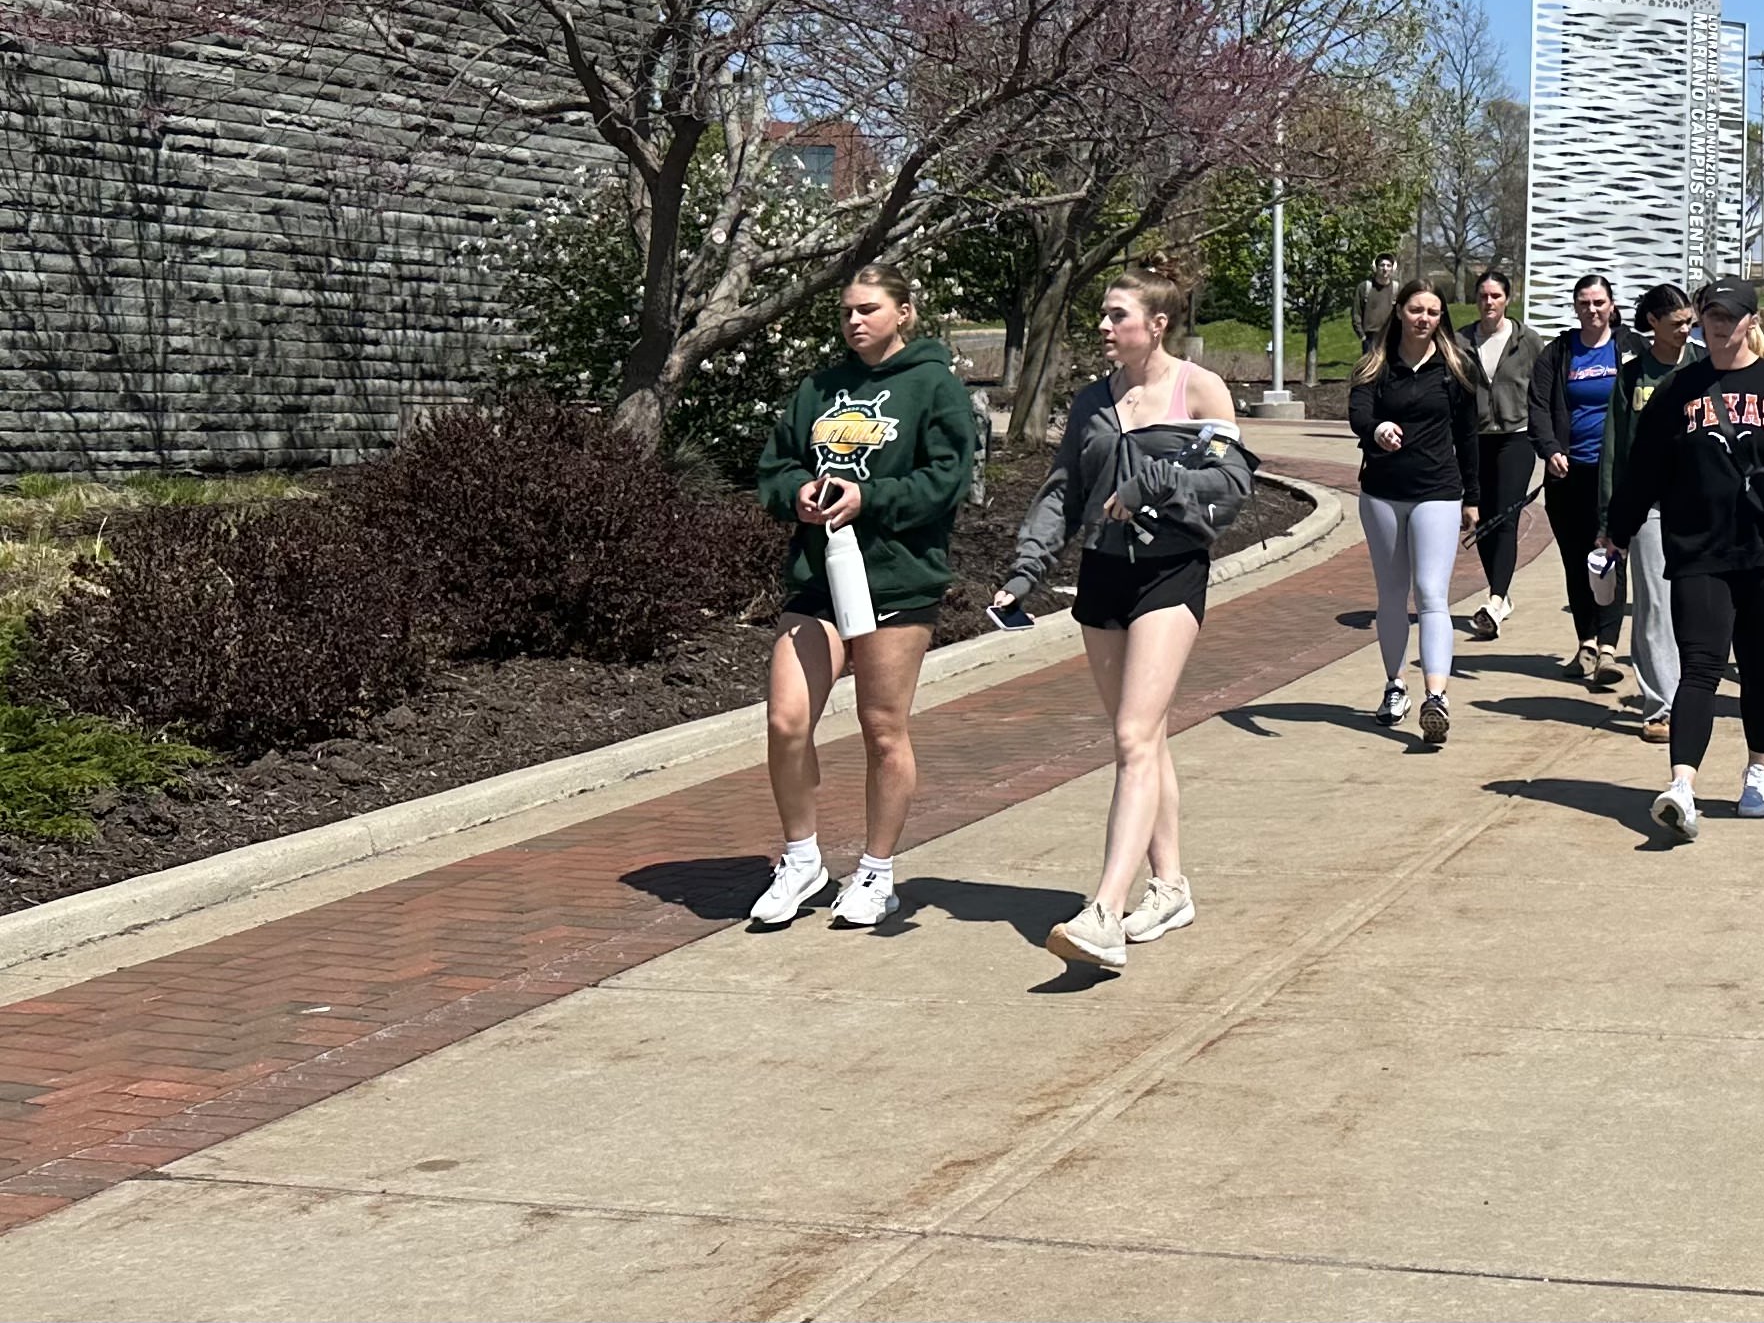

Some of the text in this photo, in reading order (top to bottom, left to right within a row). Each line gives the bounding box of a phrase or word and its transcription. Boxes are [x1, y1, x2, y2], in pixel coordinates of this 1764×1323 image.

[1707, 14, 1718, 82] LORRAINE
[1706, 102, 1717, 132] AND
[1688, 13, 1708, 281] MARANO CAMPUS CENTER
[1705, 136, 1716, 185] NUNZIO
